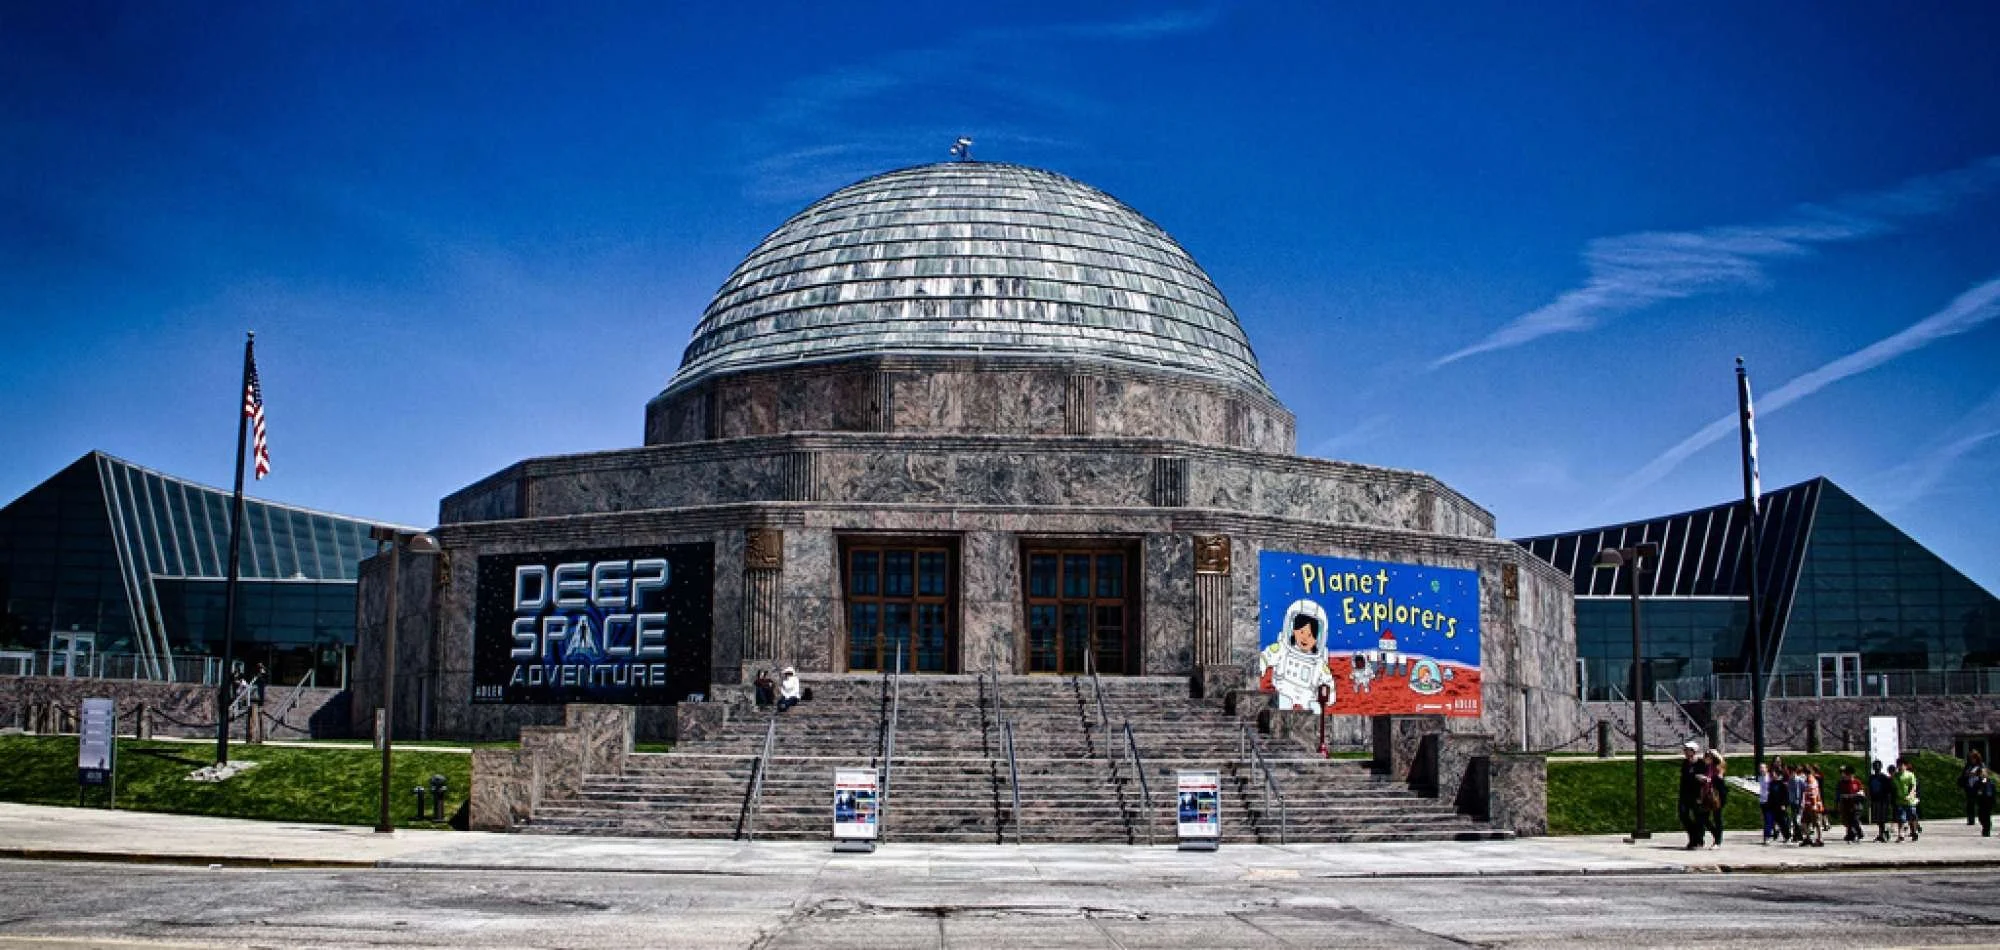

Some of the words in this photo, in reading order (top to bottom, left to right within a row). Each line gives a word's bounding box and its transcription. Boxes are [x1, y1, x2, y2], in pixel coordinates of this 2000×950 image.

[513, 558, 670, 612] DEEP
[1301, 563, 1389, 596] Planet
[510, 612, 669, 659] SPACE
[1342, 597, 1458, 639] Explorers
[509, 664, 667, 688] ADVENTURE
